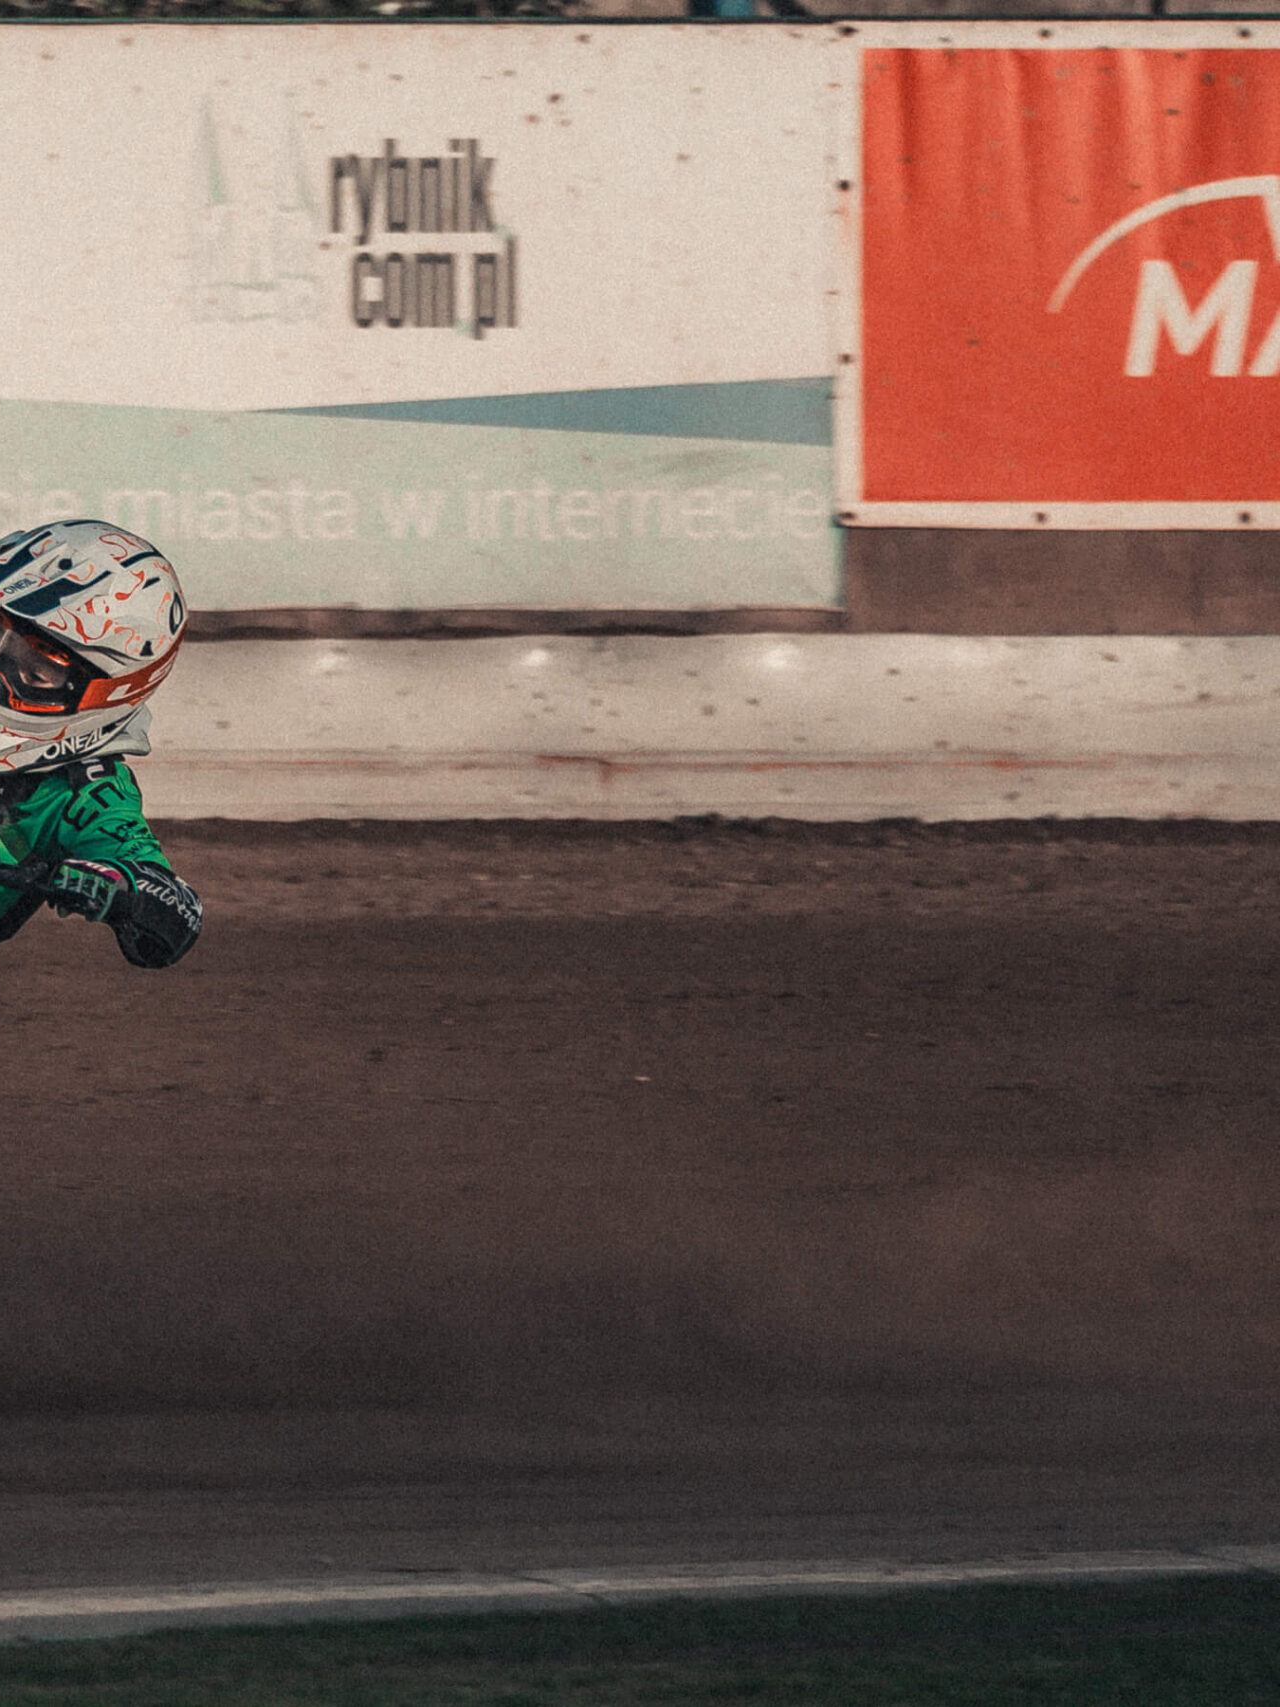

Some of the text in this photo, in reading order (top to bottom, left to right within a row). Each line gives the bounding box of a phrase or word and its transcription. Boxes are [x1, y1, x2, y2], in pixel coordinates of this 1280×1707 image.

[328, 138, 497, 246] rybnik
[1123, 259, 1280, 378] M
[108, 470, 355, 542] miasta
[379, 491, 447, 541] w
